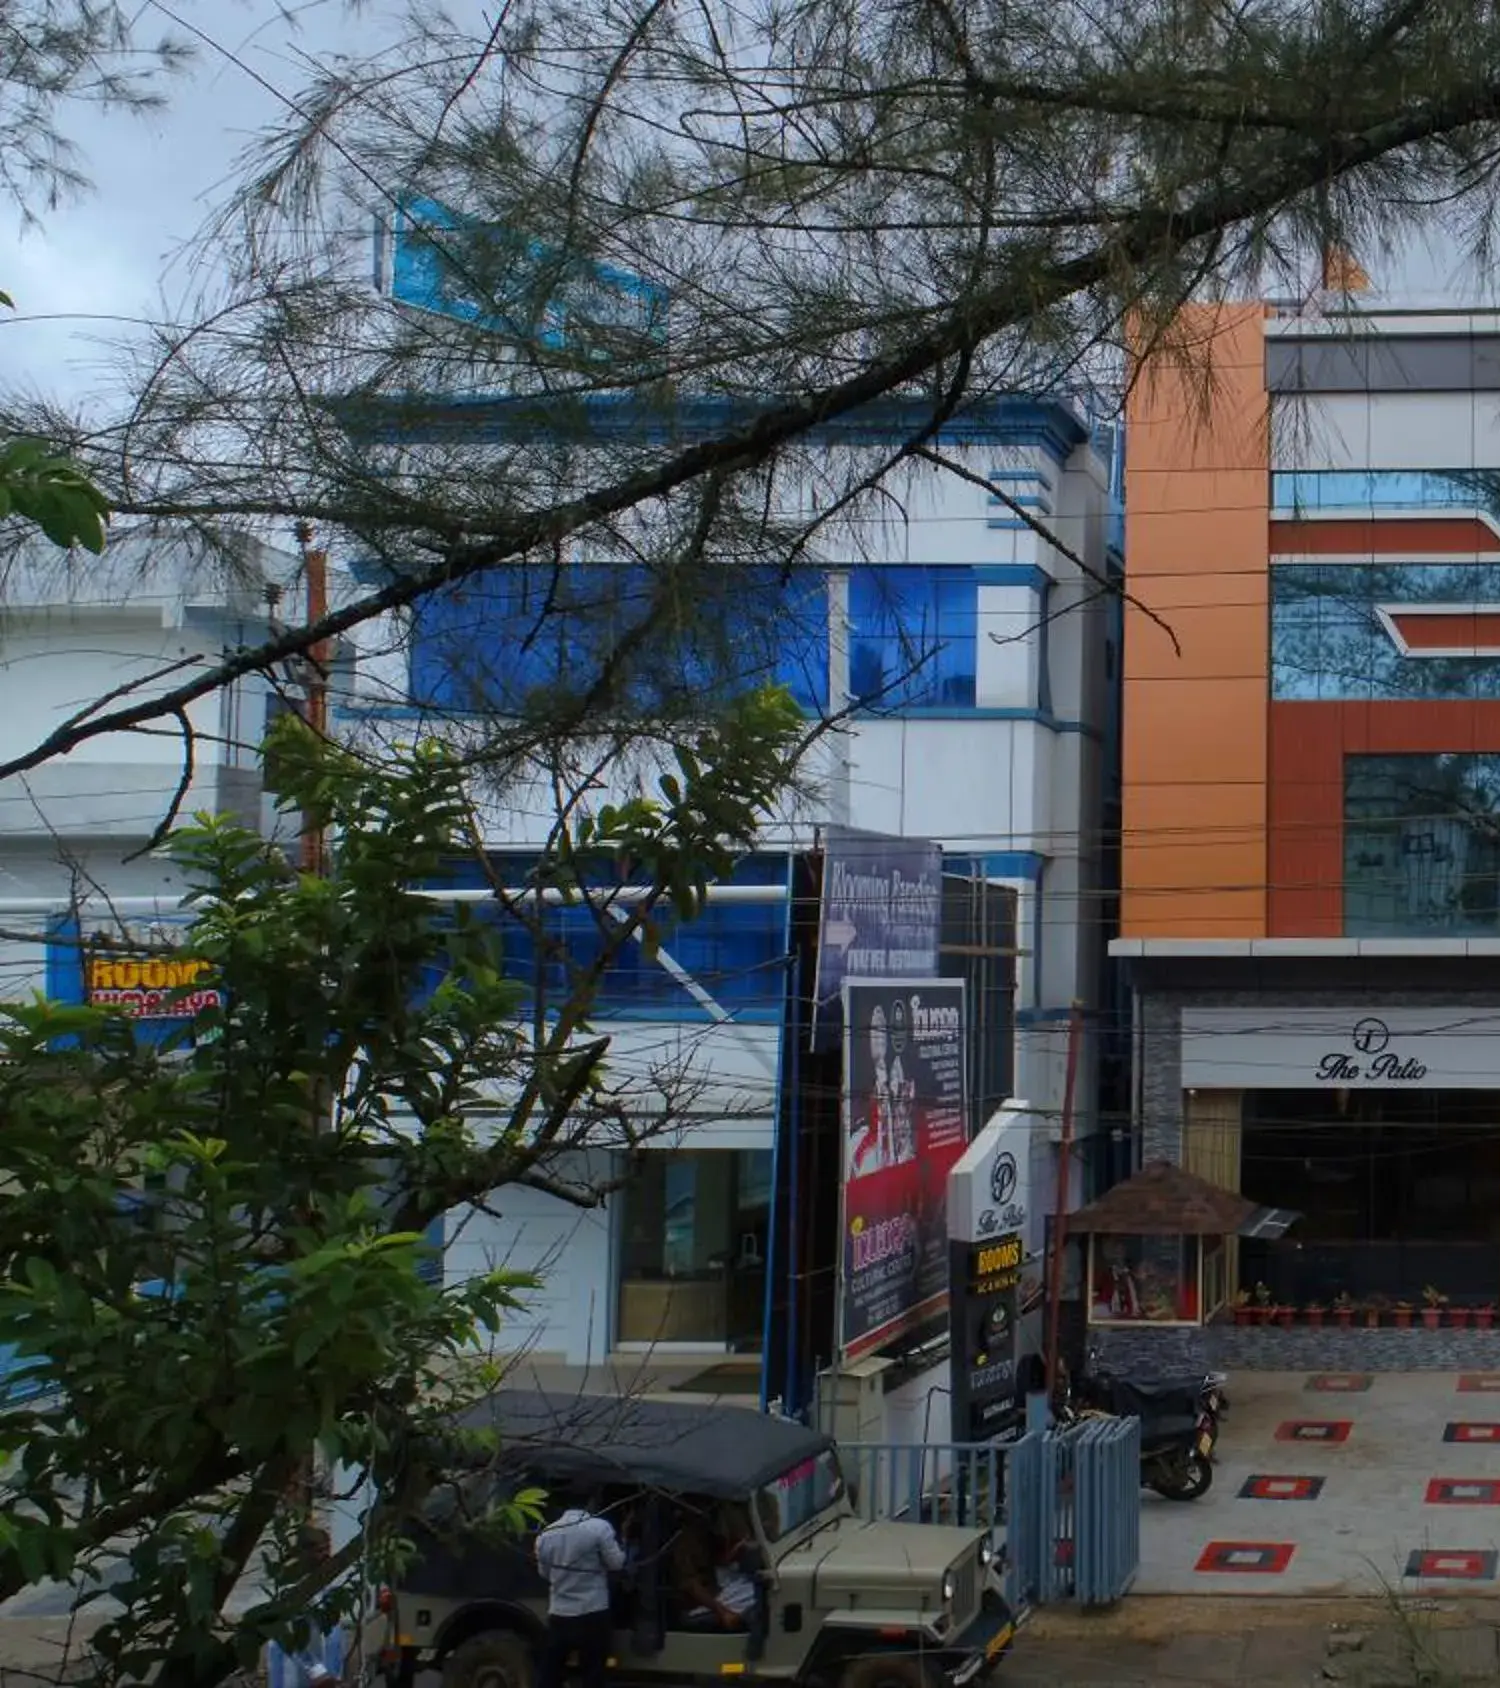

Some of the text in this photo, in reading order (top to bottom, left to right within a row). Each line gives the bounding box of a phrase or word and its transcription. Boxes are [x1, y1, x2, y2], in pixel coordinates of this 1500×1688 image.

[92, 957, 211, 989] ROOM
[1315, 1053, 1427, 1080] The Patio
[978, 1240, 1019, 1275] ROOMS
